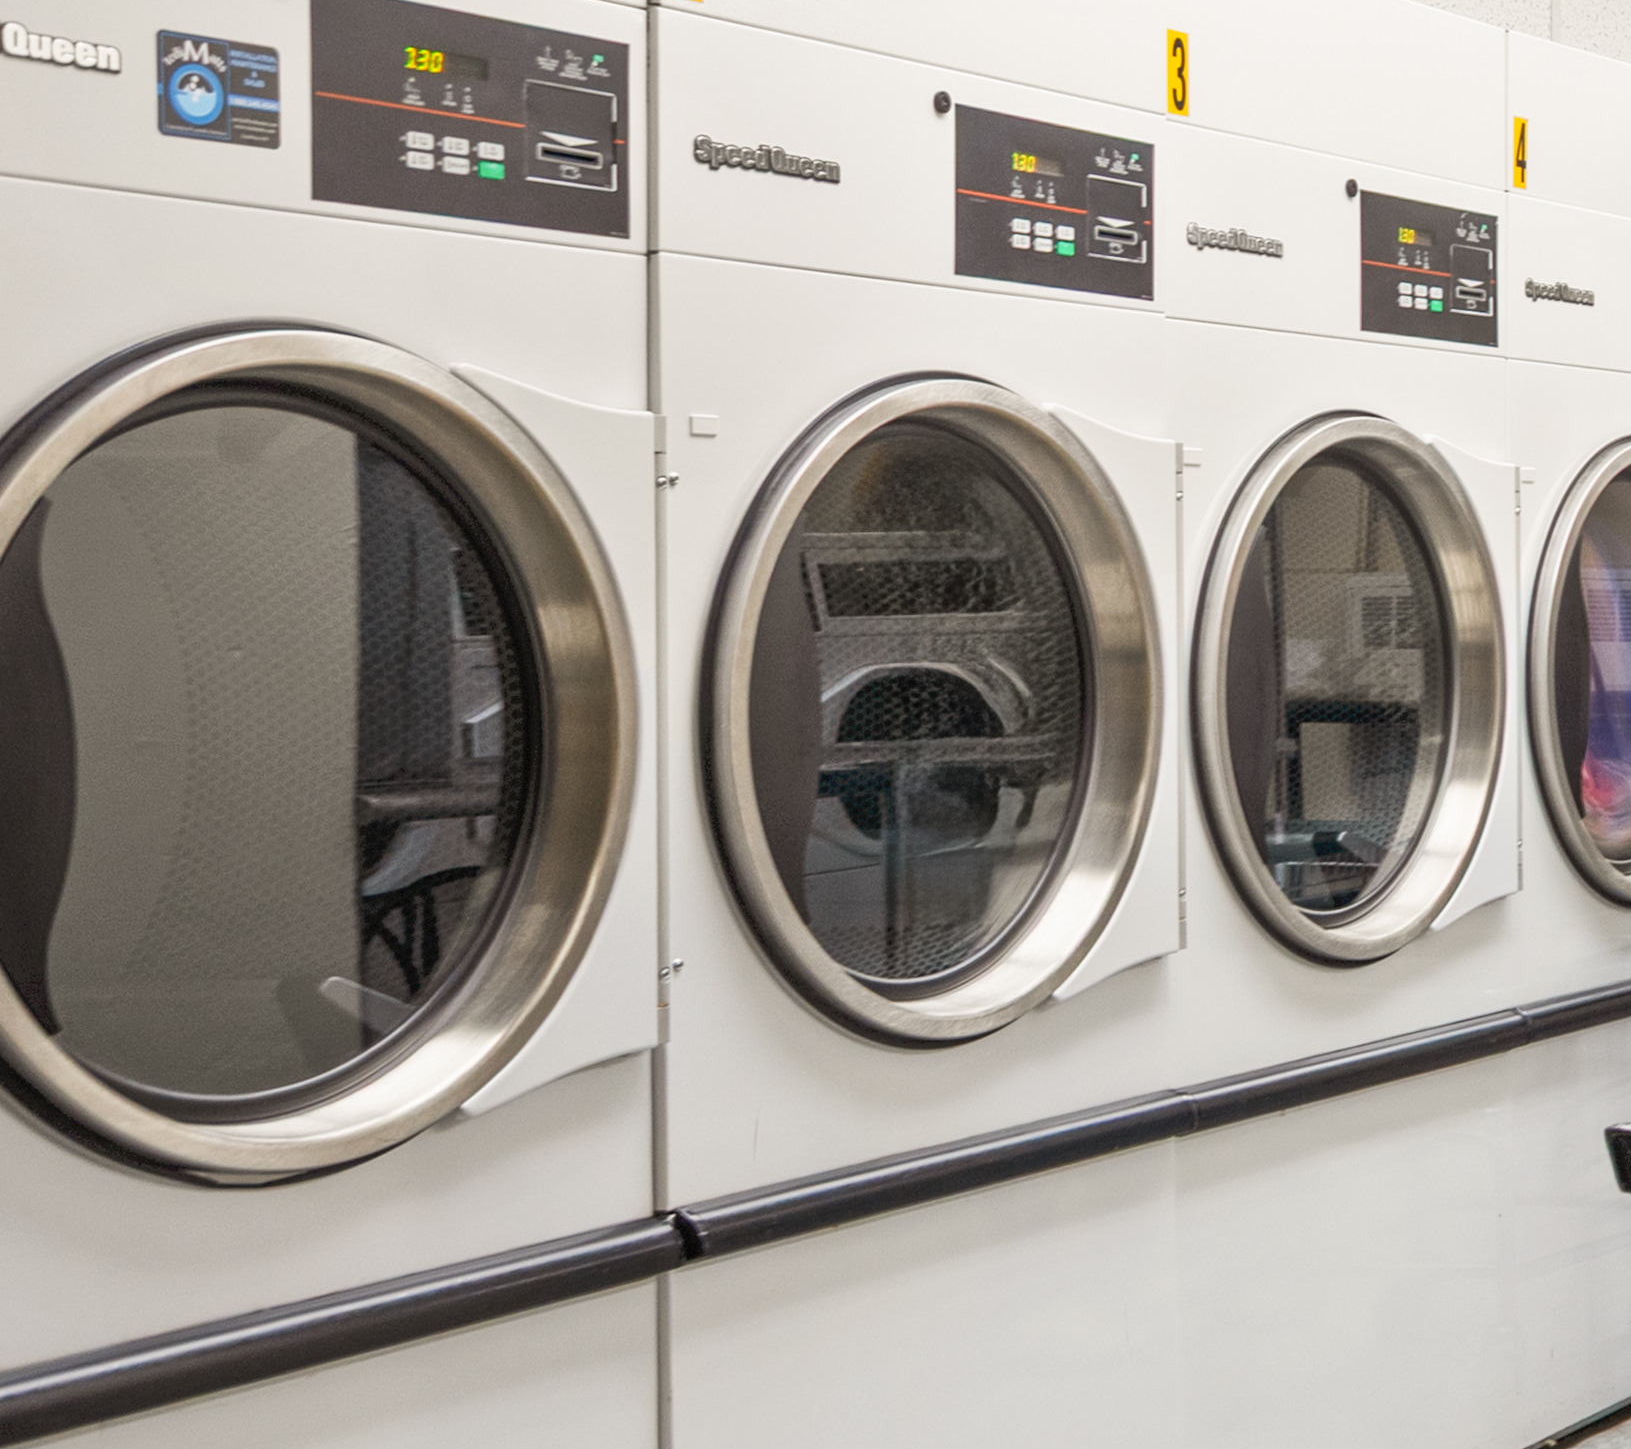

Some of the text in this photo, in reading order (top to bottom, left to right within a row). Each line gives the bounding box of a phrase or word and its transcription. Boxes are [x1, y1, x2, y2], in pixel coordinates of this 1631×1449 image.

[1, 21, 121, 74] Queen
[404, 47, 445, 73] 130
[1172, 37, 1187, 111] 3
[694, 134, 841, 184] Speed Queen
[1516, 122, 1527, 183] 4
